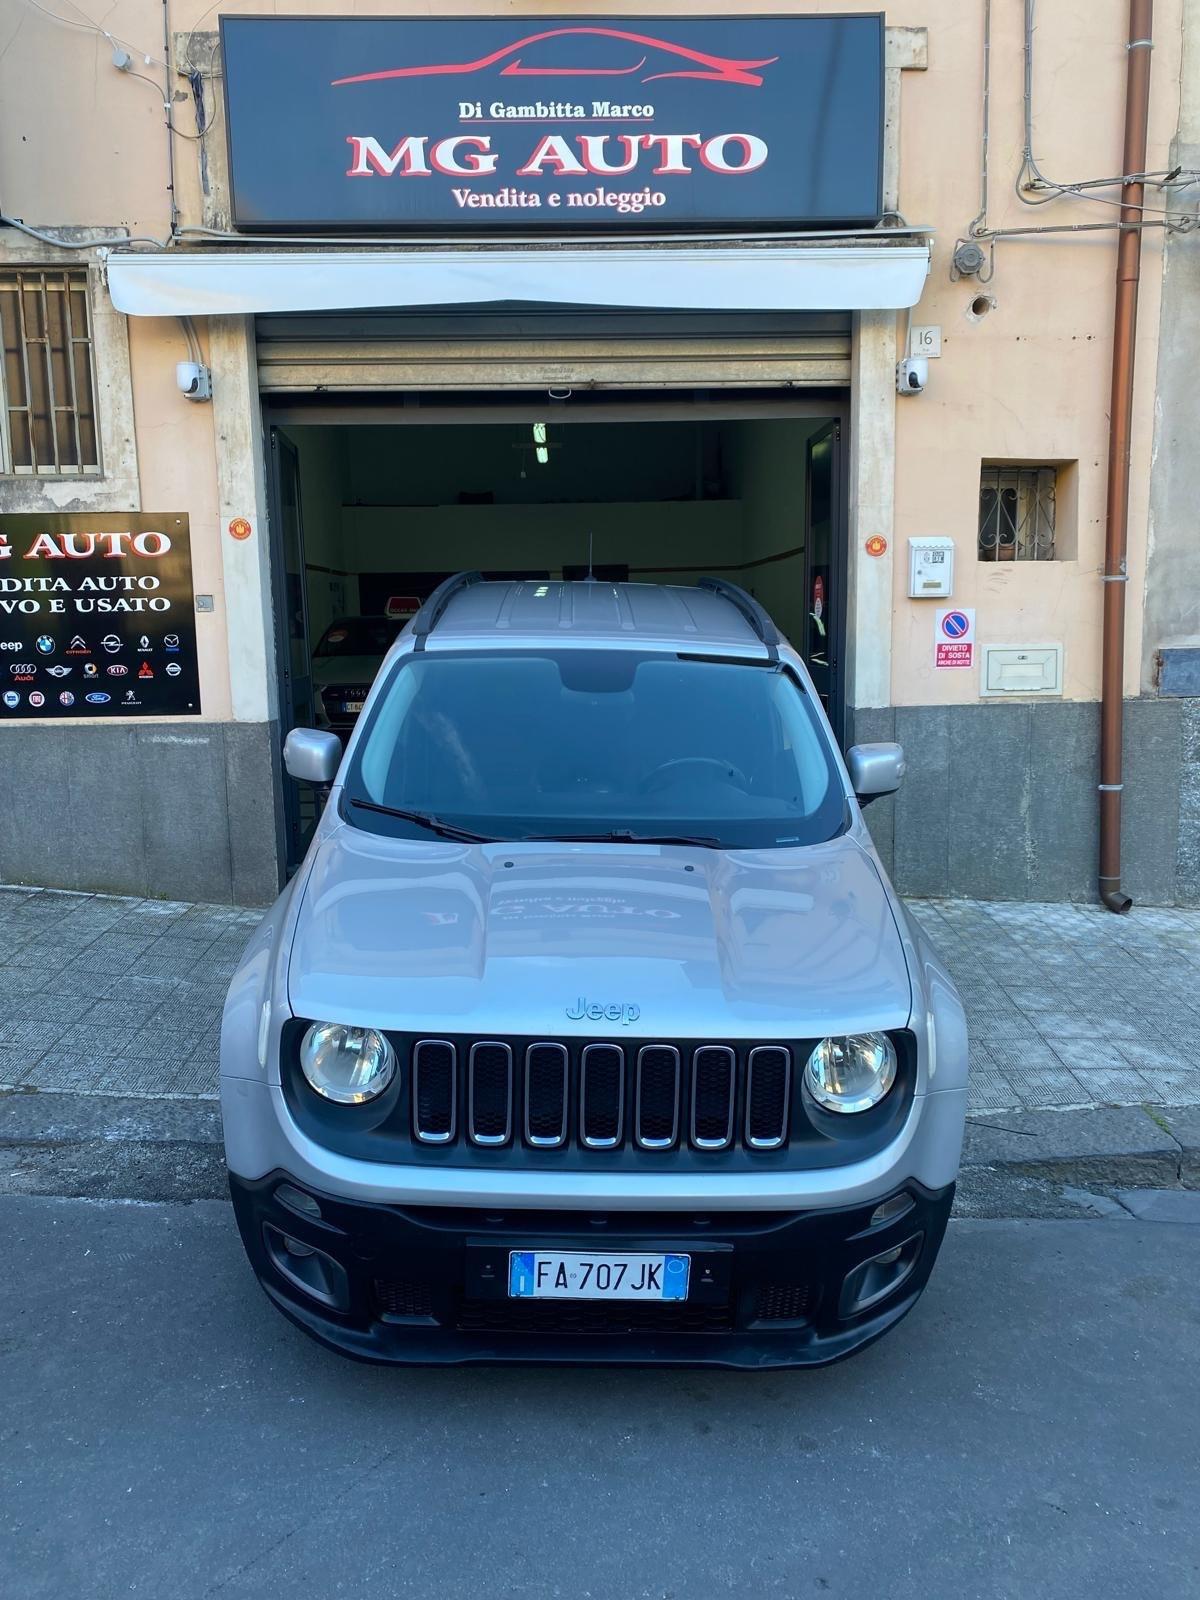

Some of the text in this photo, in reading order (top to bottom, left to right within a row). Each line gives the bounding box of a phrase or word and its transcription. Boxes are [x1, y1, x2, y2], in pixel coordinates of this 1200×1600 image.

[459, 101, 654, 119] Di Gambitta Marco
[346, 133, 768, 177] MG AUTO
[452, 187, 666, 213] Vendita e noleggio
[920, 330, 933, 345] 16
[23, 531, 172, 561] AUTO
[77, 575, 160, 591] AUTO
[49, 599, 66, 613] E
[74, 597, 171, 613] USATO
[565, 997, 641, 1026] Jeep
